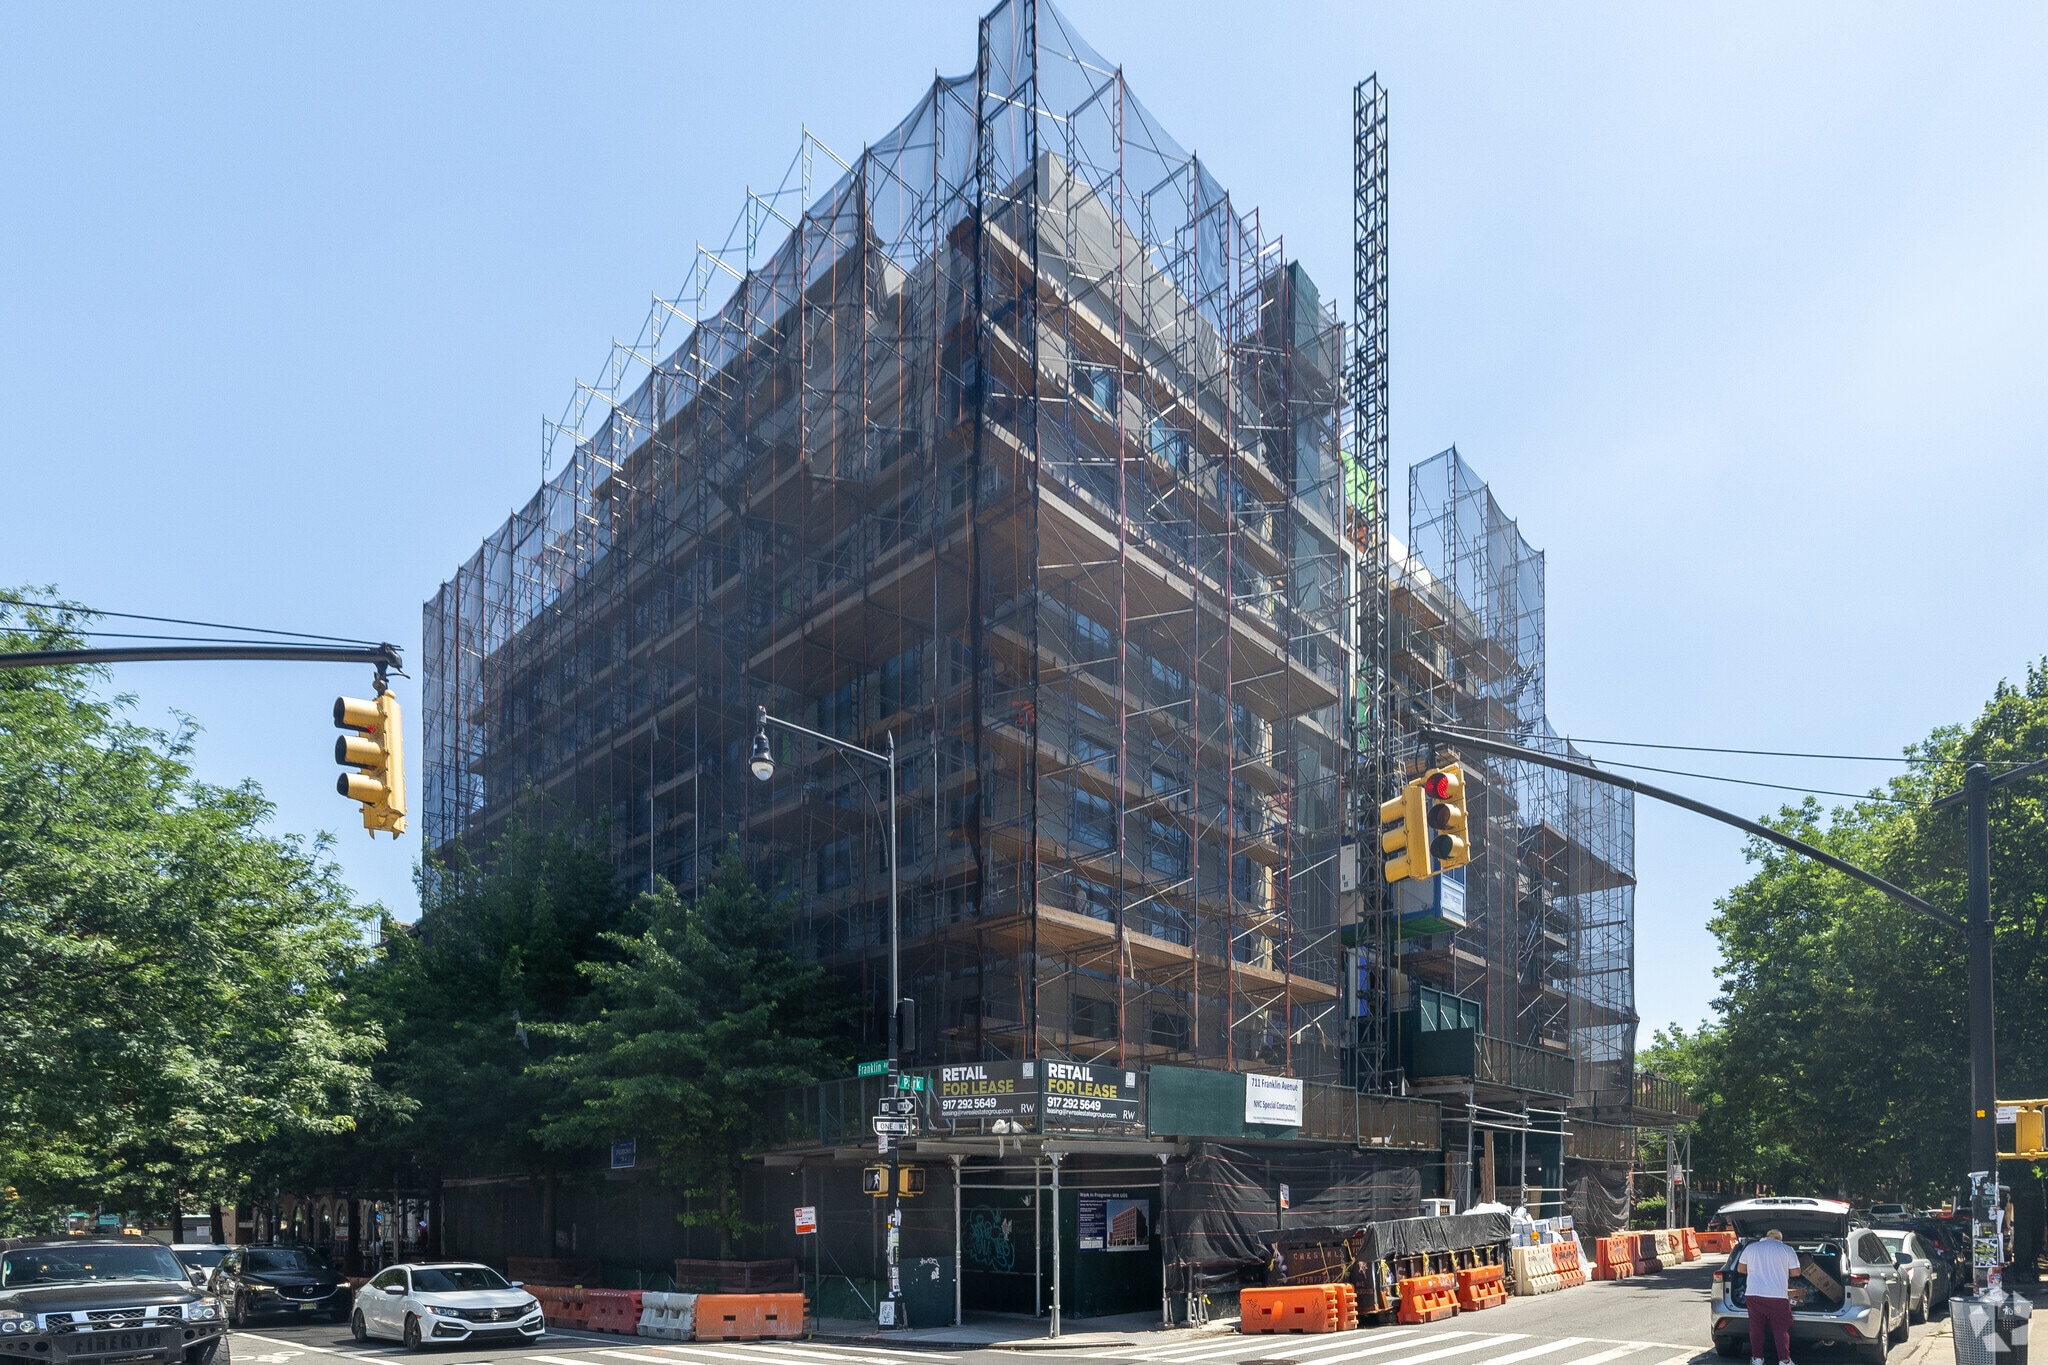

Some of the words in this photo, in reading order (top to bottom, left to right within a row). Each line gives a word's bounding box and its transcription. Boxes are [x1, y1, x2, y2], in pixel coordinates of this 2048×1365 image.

[858, 1063, 882, 1075] Franklin
[942, 1066, 988, 1081] RETAIL
[1048, 1063, 1093, 1081] RETAIL
[943, 1082, 969, 1096] FOR
[971, 1079, 1014, 1095] LEASE
[1048, 1078, 1076, 1095] FOR
[1077, 1081, 1117, 1099] LEASE
[1251, 1077, 1261, 1087] 711
[1261, 1079, 1281, 1089] Franklin
[1281, 1081, 1298, 1091] Avenue
[942, 1100, 956, 1110] 917
[957, 1099, 973, 1109] 292
[974, 1098, 997, 1108] 5649
[1020, 1103, 1035, 1113] RW
[1047, 1097, 1062, 1108] 917
[1063, 1098, 1078, 1109] 292
[1079, 1099, 1101, 1111] 5649
[1253, 1100, 1262, 1108] NYC
[1262, 1100, 1277, 1110] Special
[1123, 1110, 1135, 1120] RW
[75, 1332, 161, 1353] FIREGYM
